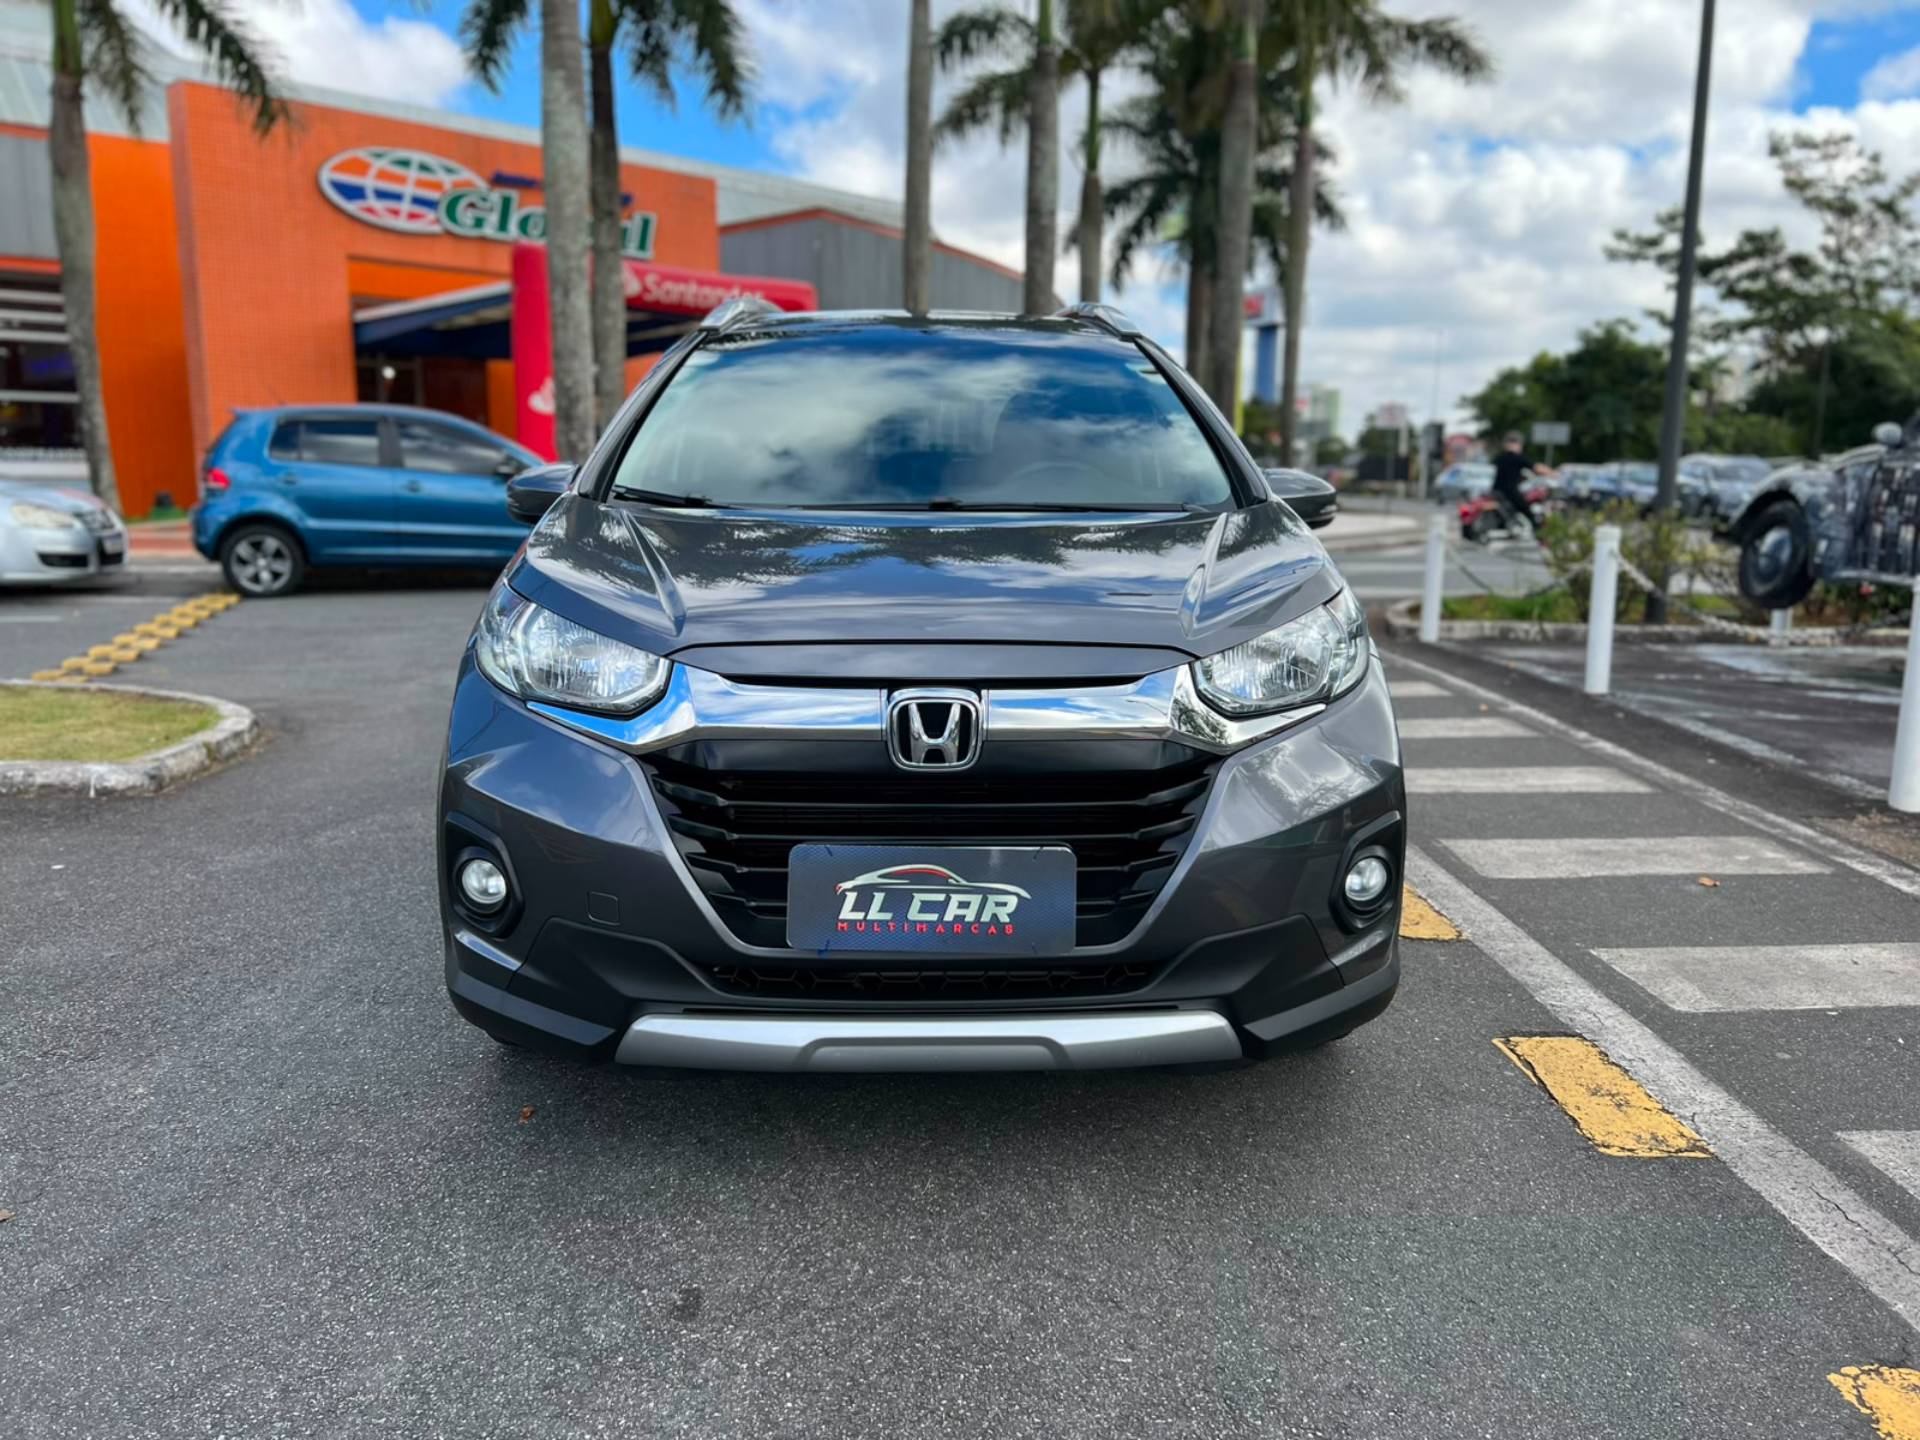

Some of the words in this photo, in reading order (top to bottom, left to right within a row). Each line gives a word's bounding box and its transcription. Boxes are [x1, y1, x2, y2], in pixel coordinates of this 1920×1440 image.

[442, 189, 655, 256] Glol
[838, 892, 893, 920] LL
[907, 893, 1019, 923] CAR
[835, 921, 1016, 935] MULTIMARCAS
